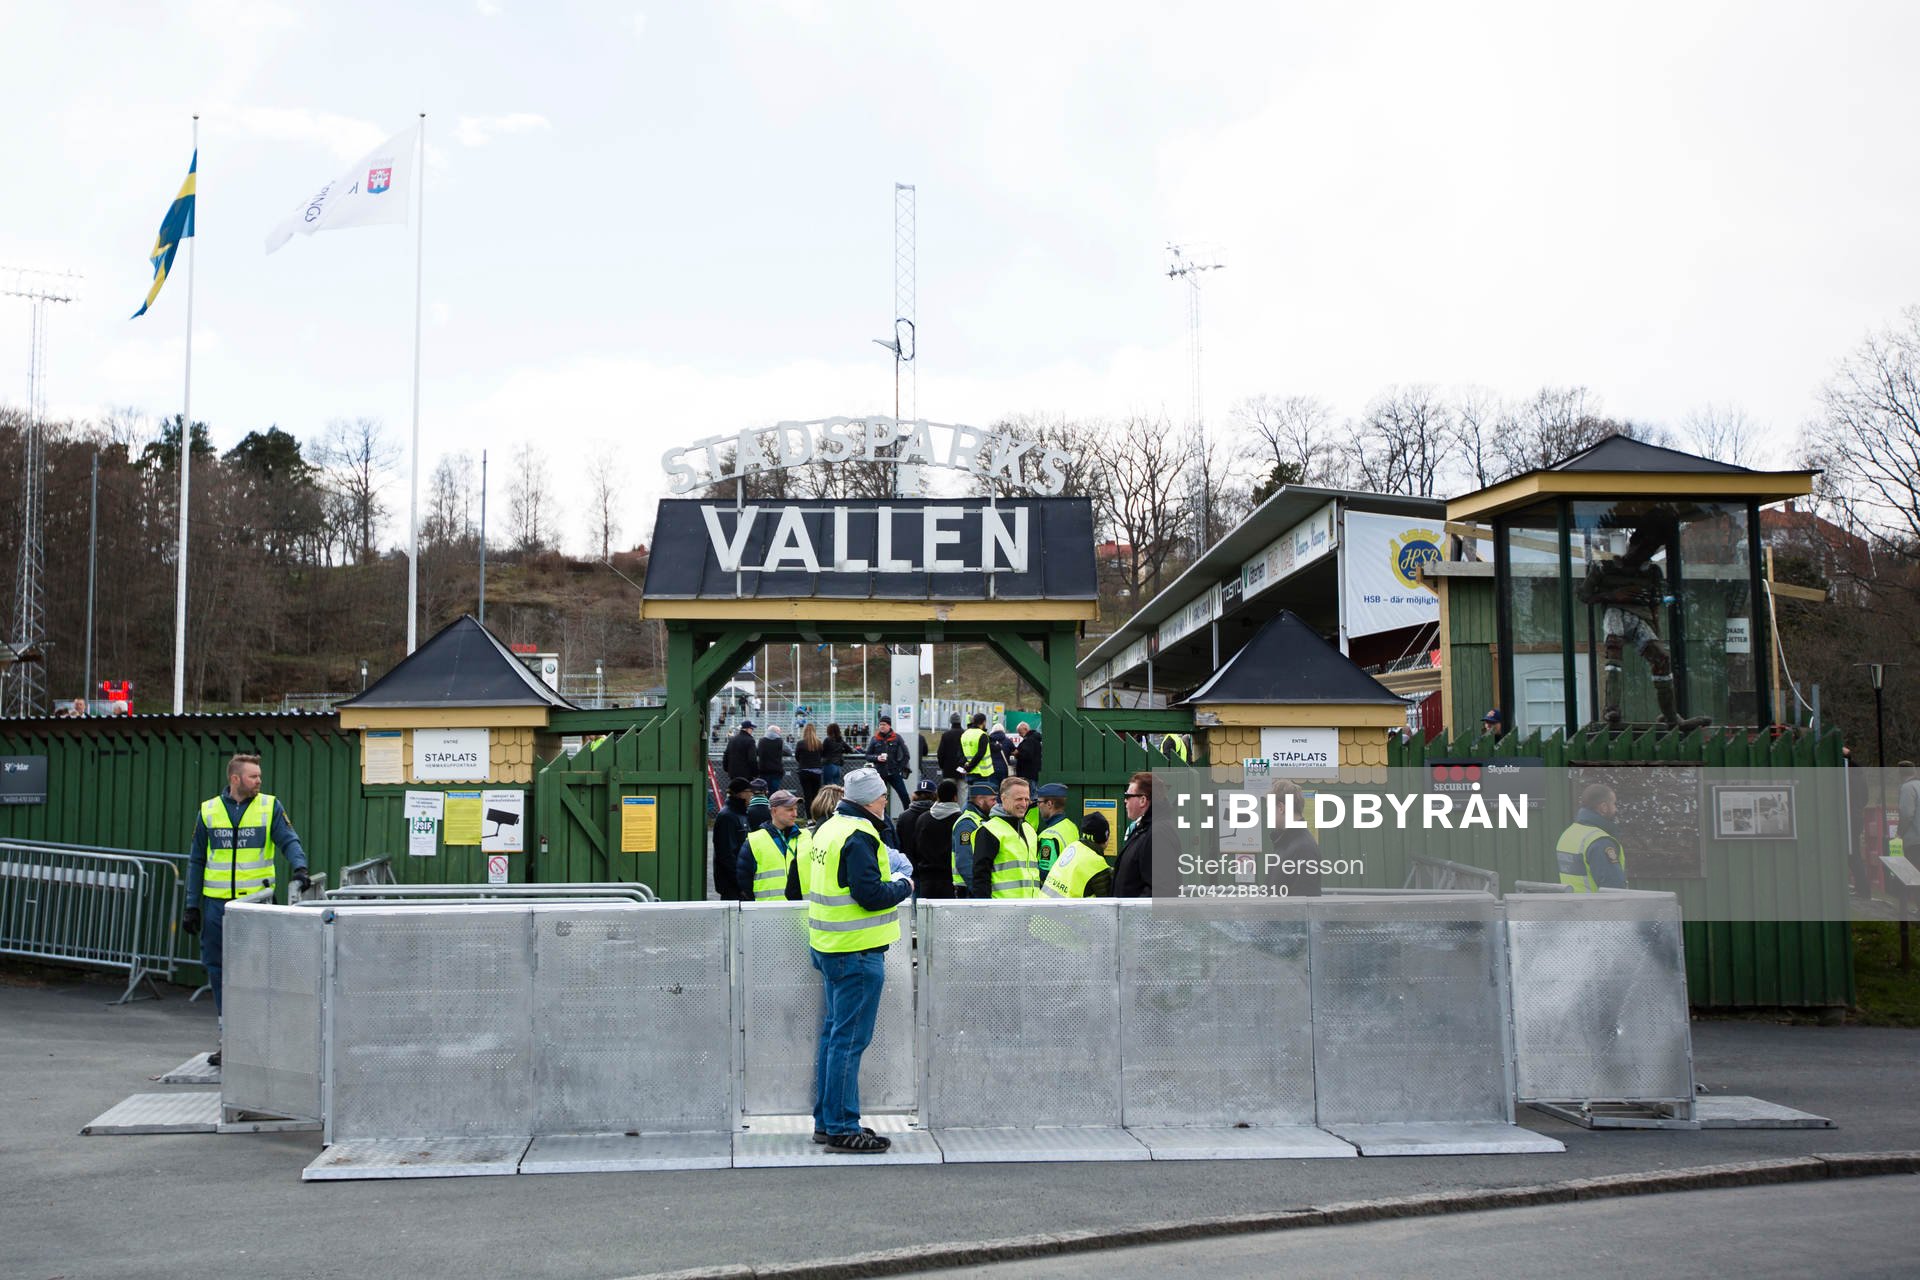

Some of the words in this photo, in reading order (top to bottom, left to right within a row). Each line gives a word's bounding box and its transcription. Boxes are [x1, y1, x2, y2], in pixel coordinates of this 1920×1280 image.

[661, 416, 1073, 495] STADSPARKS
[700, 505, 1029, 573] VALLEN
[1363, 595, 1381, 603] HSB
[1390, 595, 1404, 603] där
[424, 752, 477, 762] STÅPLATS
[1272, 752, 1327, 761] STÅPLATS
[1248, 763, 1268, 773] JSIF
[1487, 765, 1520, 774] Skyddar
[921, 781, 928, 789] U
[1433, 783, 1480, 791] SECURIT
